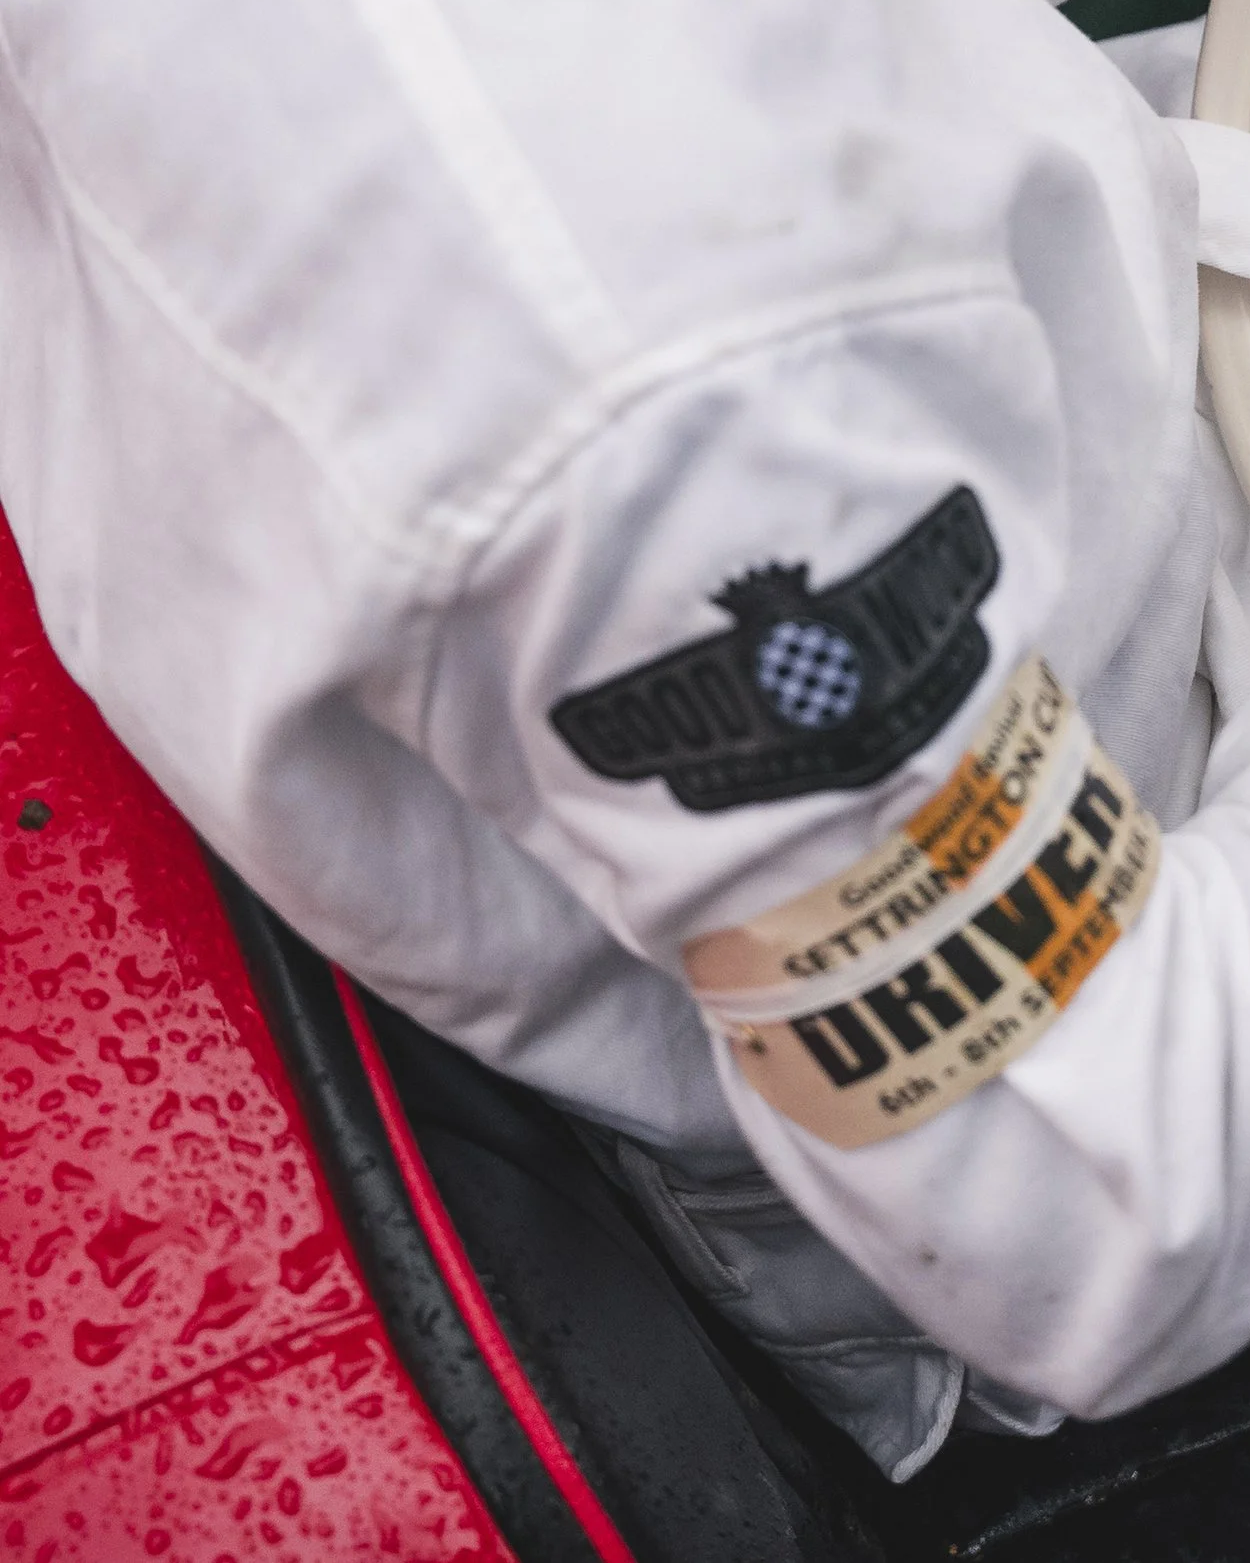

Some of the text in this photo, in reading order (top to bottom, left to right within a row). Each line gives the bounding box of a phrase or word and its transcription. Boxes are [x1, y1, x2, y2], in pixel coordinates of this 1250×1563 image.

[782, 732, 1044, 978] SETTRINGTON
[877, 1071, 939, 1116] 6th
[961, 1012, 1022, 1063] 8th
[1018, 827, 1150, 1018] SEPTEMBER
